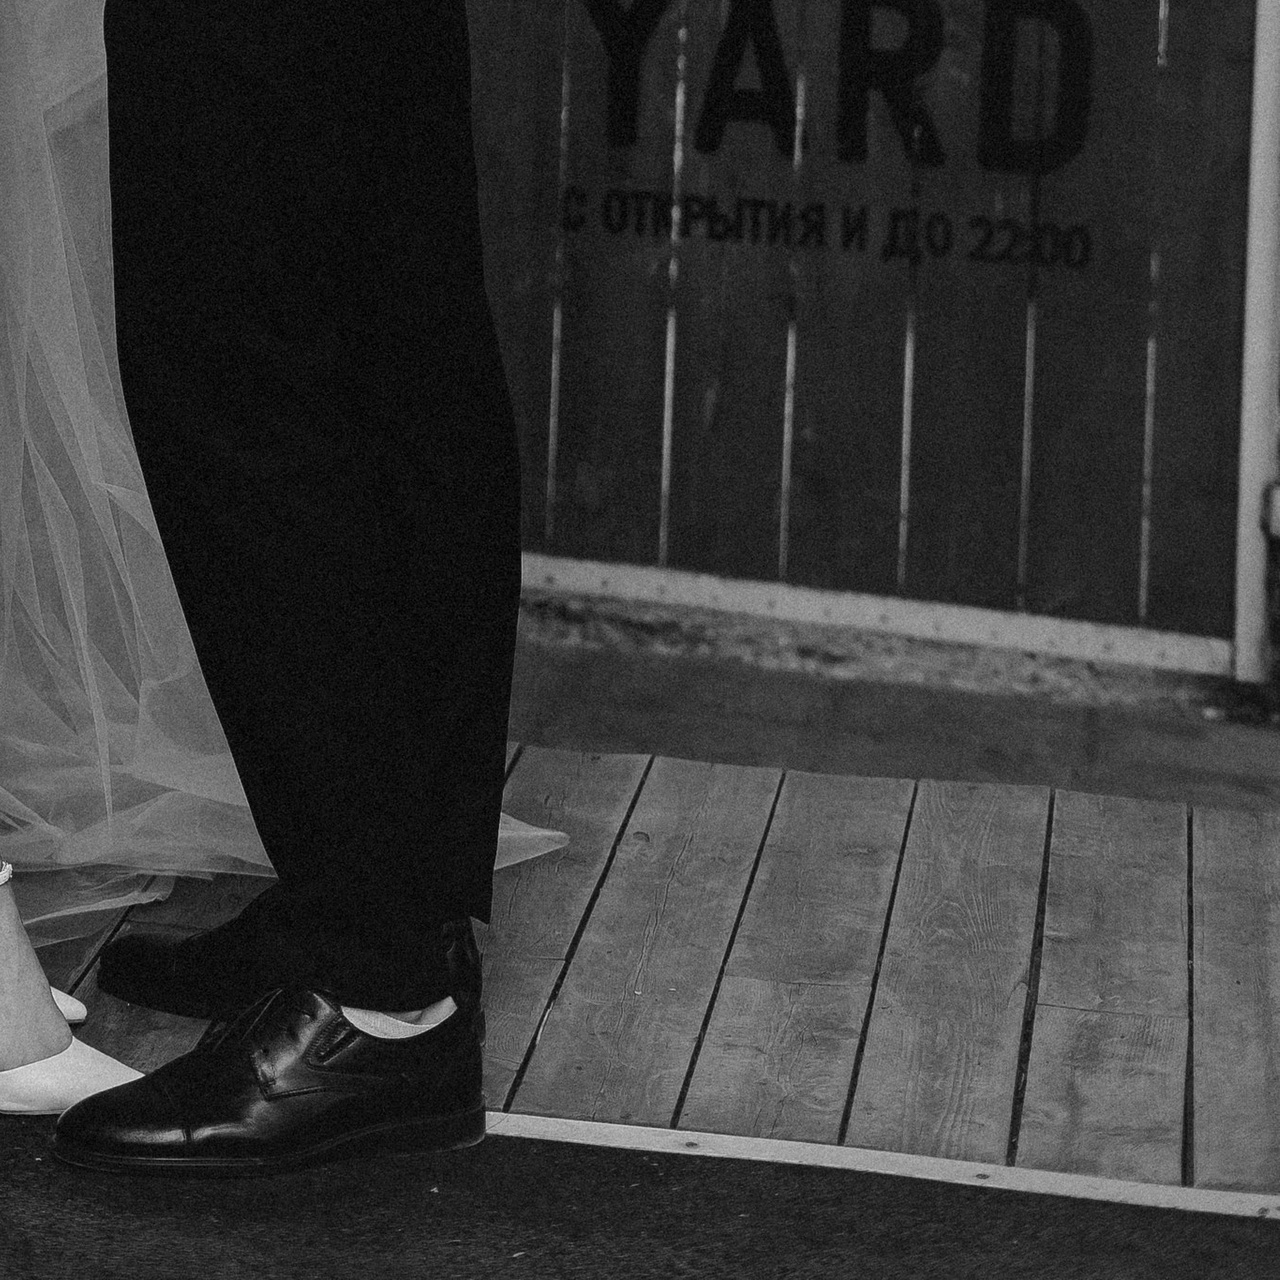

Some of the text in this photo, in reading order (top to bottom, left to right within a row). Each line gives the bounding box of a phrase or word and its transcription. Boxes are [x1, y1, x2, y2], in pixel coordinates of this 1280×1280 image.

[602, 190, 825, 248] ОТКРЫТИЯ
[841, 204, 868, 252] И
[882, 207, 953, 266] ДО
